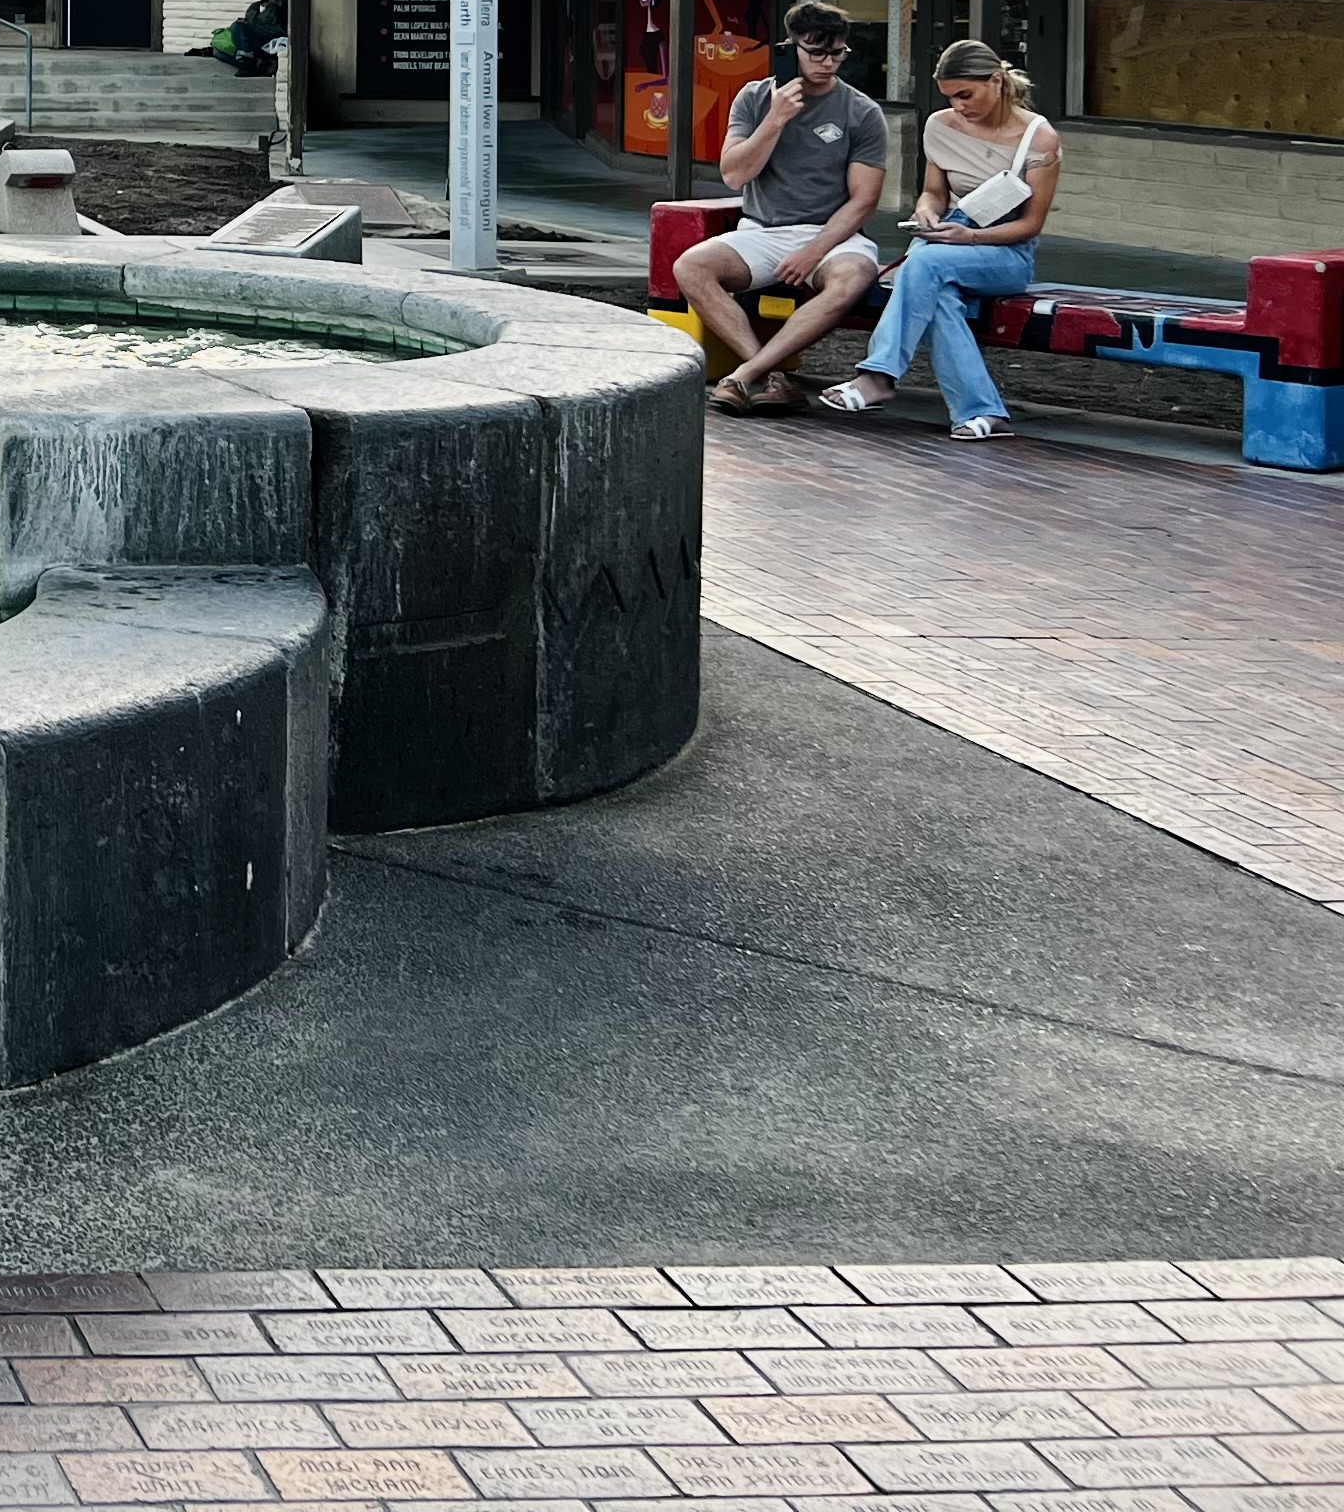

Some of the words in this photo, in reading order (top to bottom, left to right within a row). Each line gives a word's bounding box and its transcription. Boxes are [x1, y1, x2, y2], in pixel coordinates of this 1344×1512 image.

[482, 51, 494, 99] Amani
[334, 1276, 381, 1287] PAM
[390, 1276, 432, 1287] AND
[488, 1317, 547, 1328] CARL
[718, 1325, 802, 1336] TAYLOR
[458, 1362, 556, 1374] ROSETTE
[535, 1408, 619, 1421] MARGE
[160, 1419, 223, 1433] SARA
[235, 1419, 304, 1433] HICKS
[347, 1419, 412, 1432] ROSS
[420, 1417, 510, 1430] TAYLOR
[597, 1426, 653, 1437] BELL
[372, 1458, 423, 1472] ANN
[731, 1455, 805, 1468] PETER
[480, 1465, 568, 1480] ERNEST
